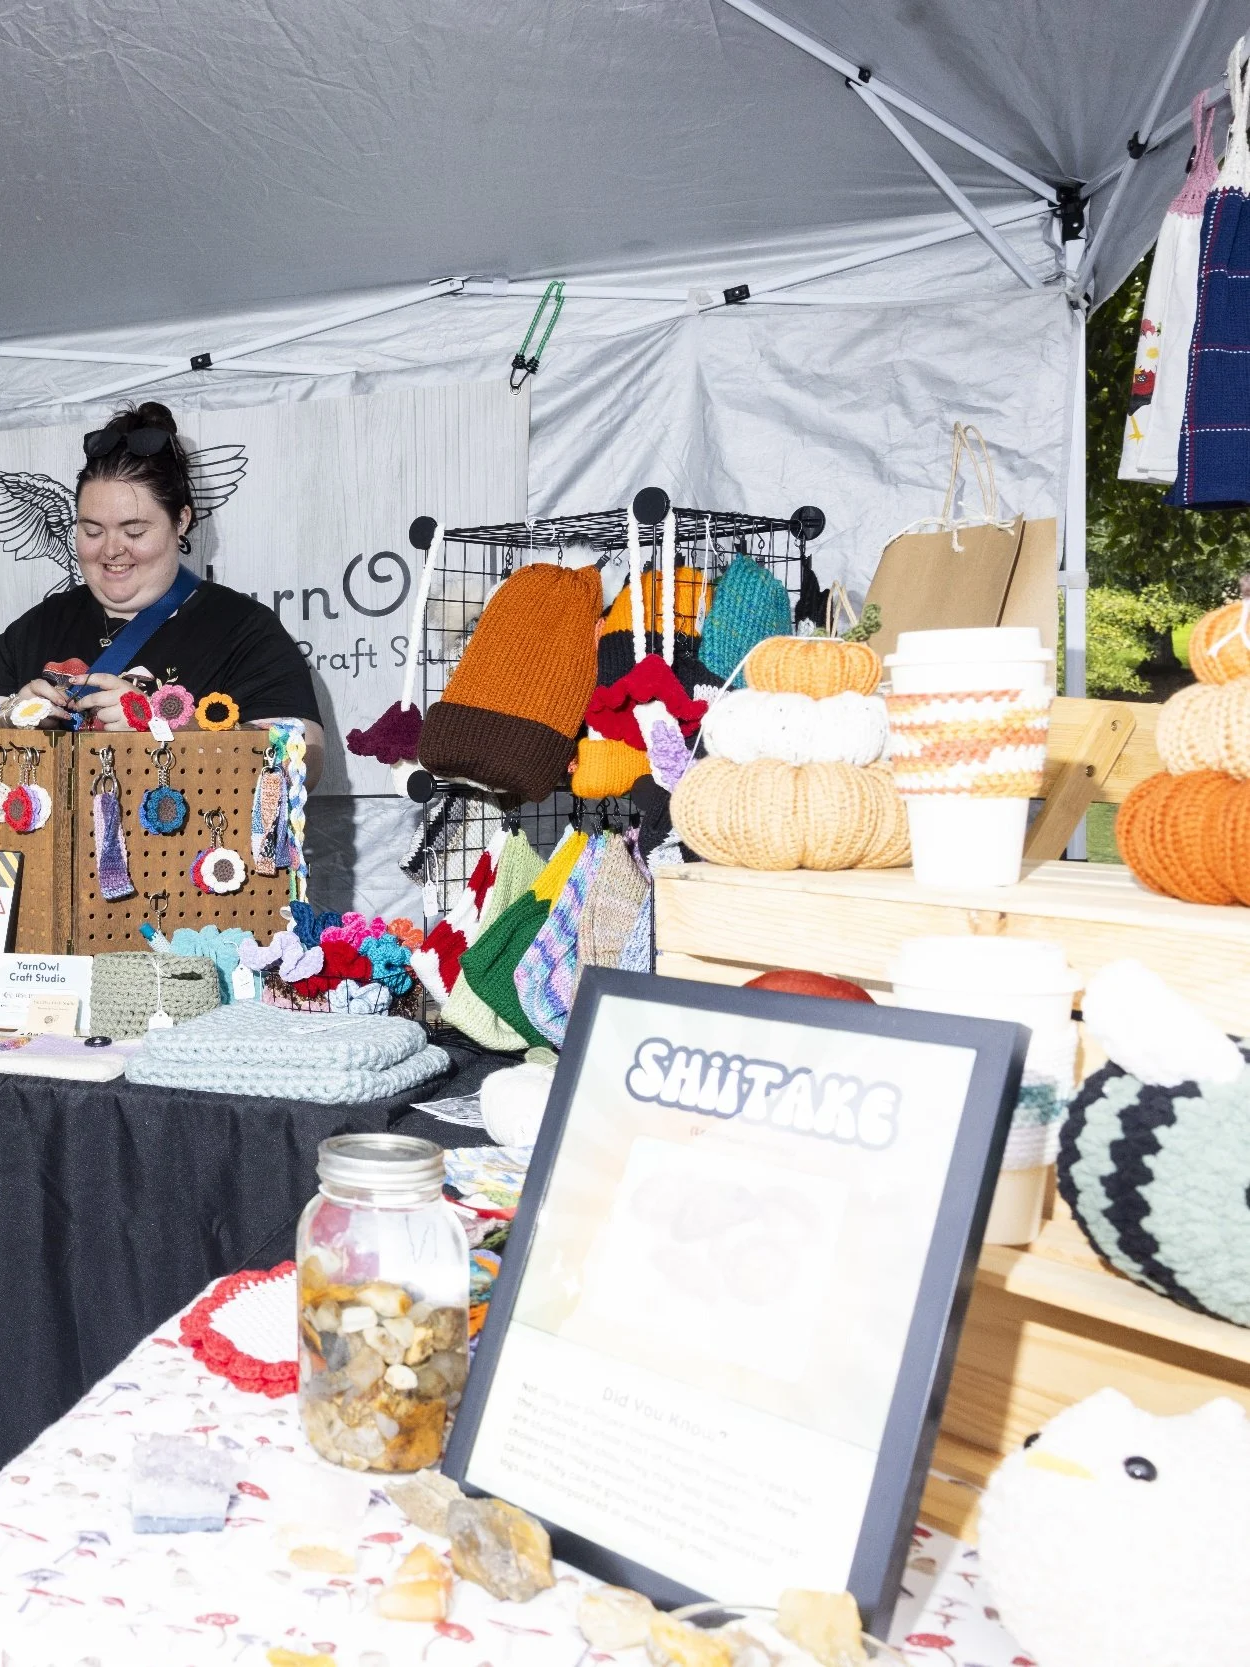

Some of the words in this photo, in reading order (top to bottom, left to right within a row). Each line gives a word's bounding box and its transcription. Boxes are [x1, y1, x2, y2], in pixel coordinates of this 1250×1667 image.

[17, 961, 60, 971] YarnOwl
[9, 972, 33, 982] Craft
[35, 973, 66, 983] Studio
[602, 1386, 628, 1408] Did
[634, 1396, 664, 1423] You
